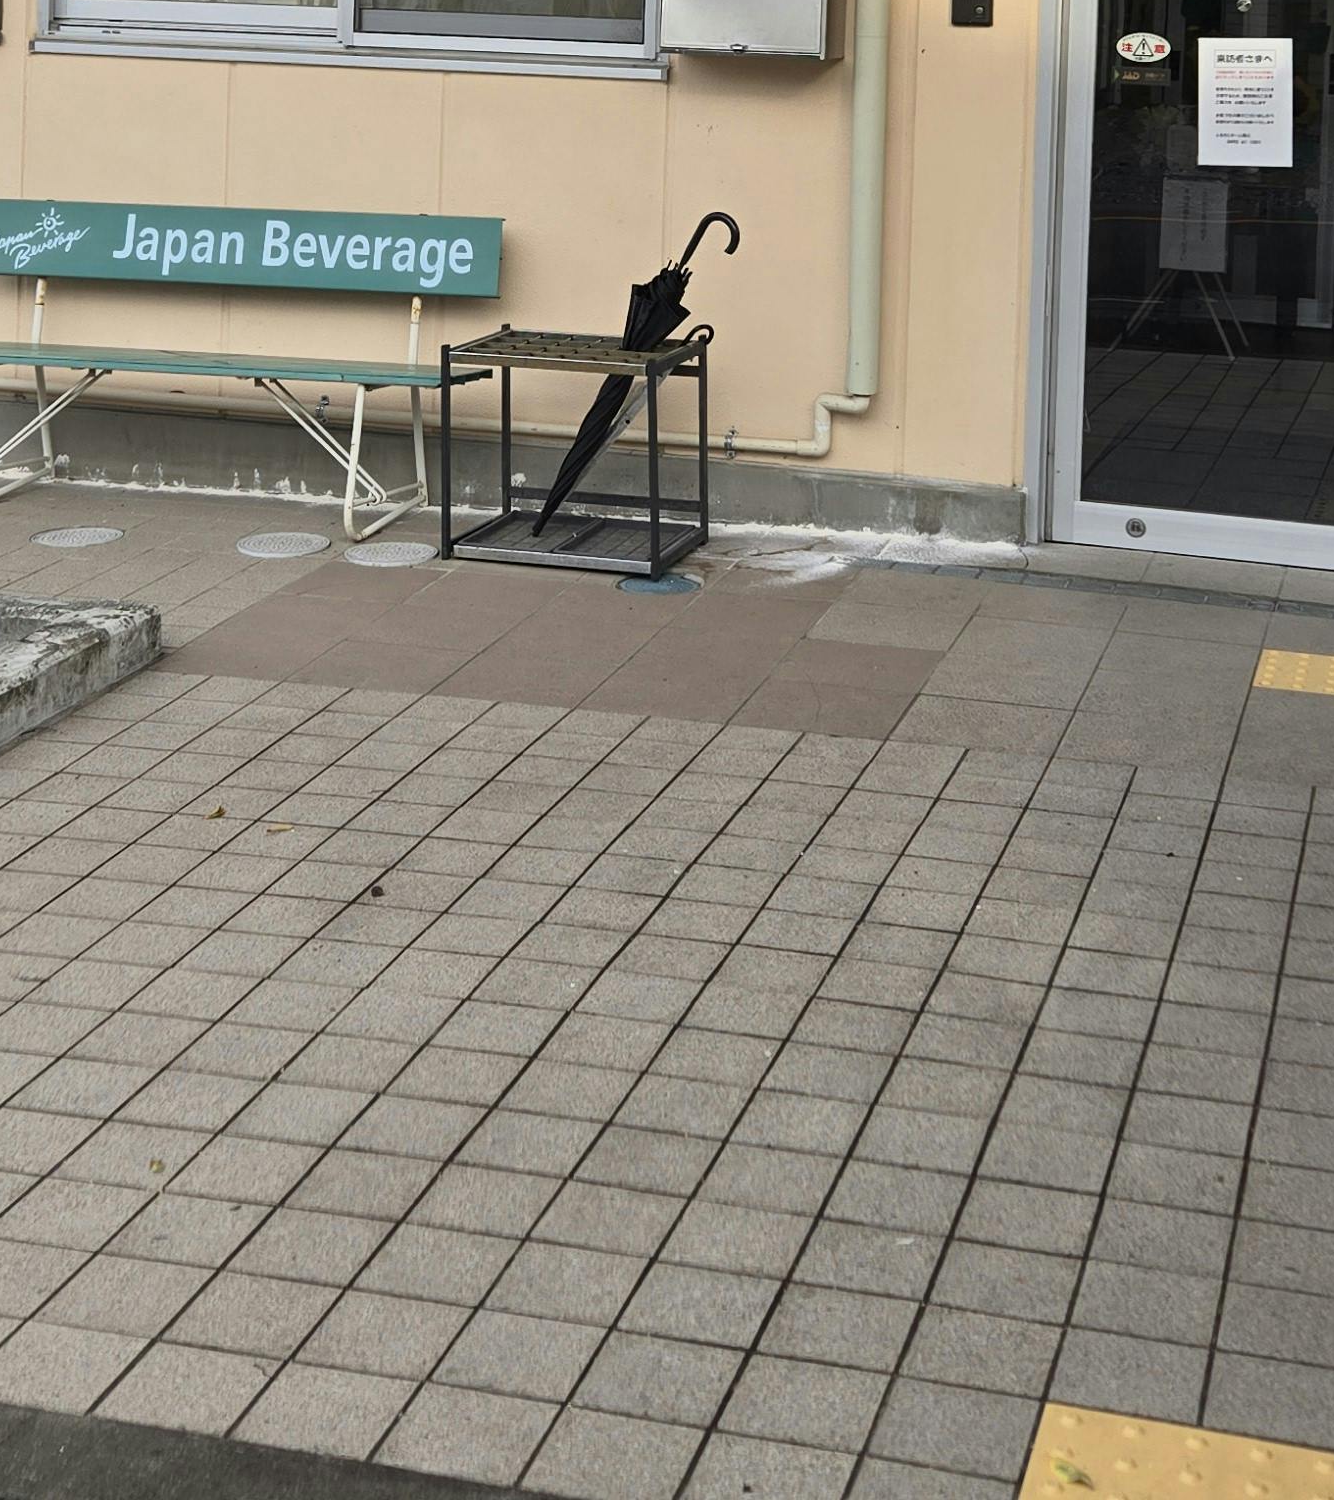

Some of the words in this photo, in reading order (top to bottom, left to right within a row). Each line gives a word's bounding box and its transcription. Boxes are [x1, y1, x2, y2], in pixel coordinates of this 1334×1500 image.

[9, 226, 91, 269] Beverage
[112, 213, 245, 276] Japan
[261, 219, 474, 288] Beverage
